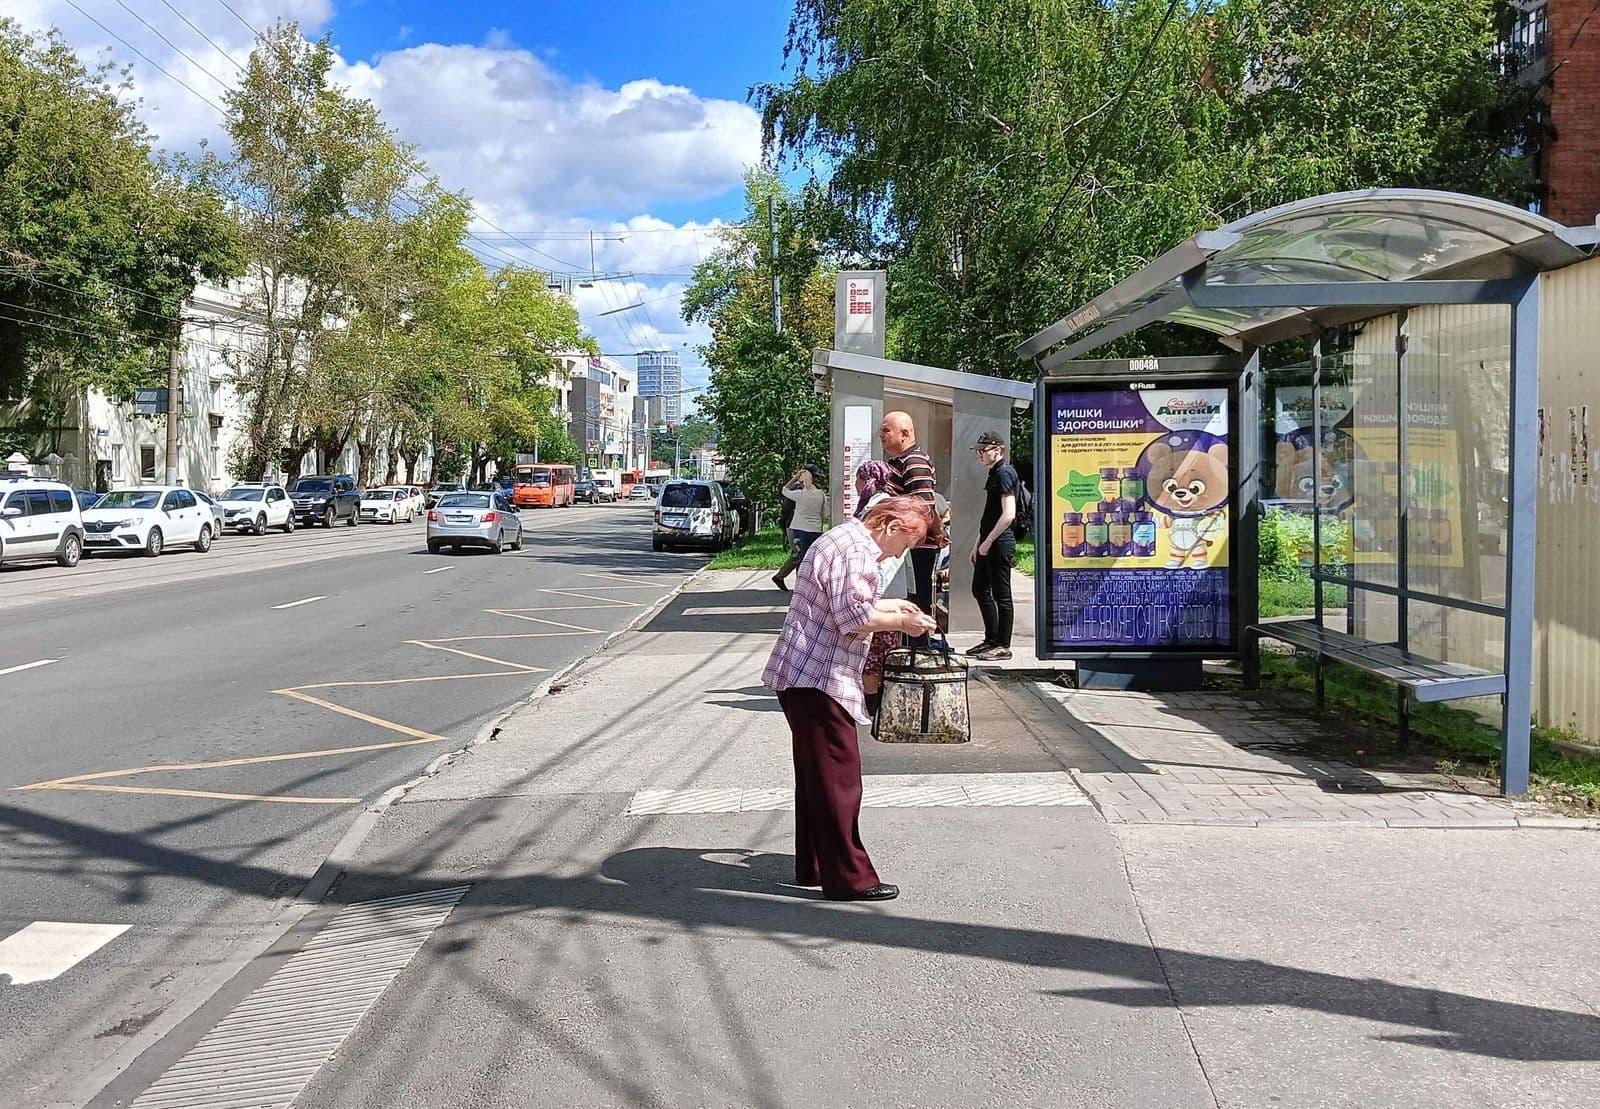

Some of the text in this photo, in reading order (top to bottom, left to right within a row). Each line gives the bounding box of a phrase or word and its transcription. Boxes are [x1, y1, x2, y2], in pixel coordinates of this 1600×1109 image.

[1057, 408, 1102, 419] МИШКИ
[1058, 592, 1102, 605] ПОЛУЧЕНИЕ
[1106, 592, 1165, 606] КОНСУЛЬТАЦИИ
[1083, 605, 1097, 639] НЕ
[1098, 605, 1151, 639] ЯВЛЯЕТСЯ
[1152, 605, 1222, 639] ЛЕКАРСТВОМ
